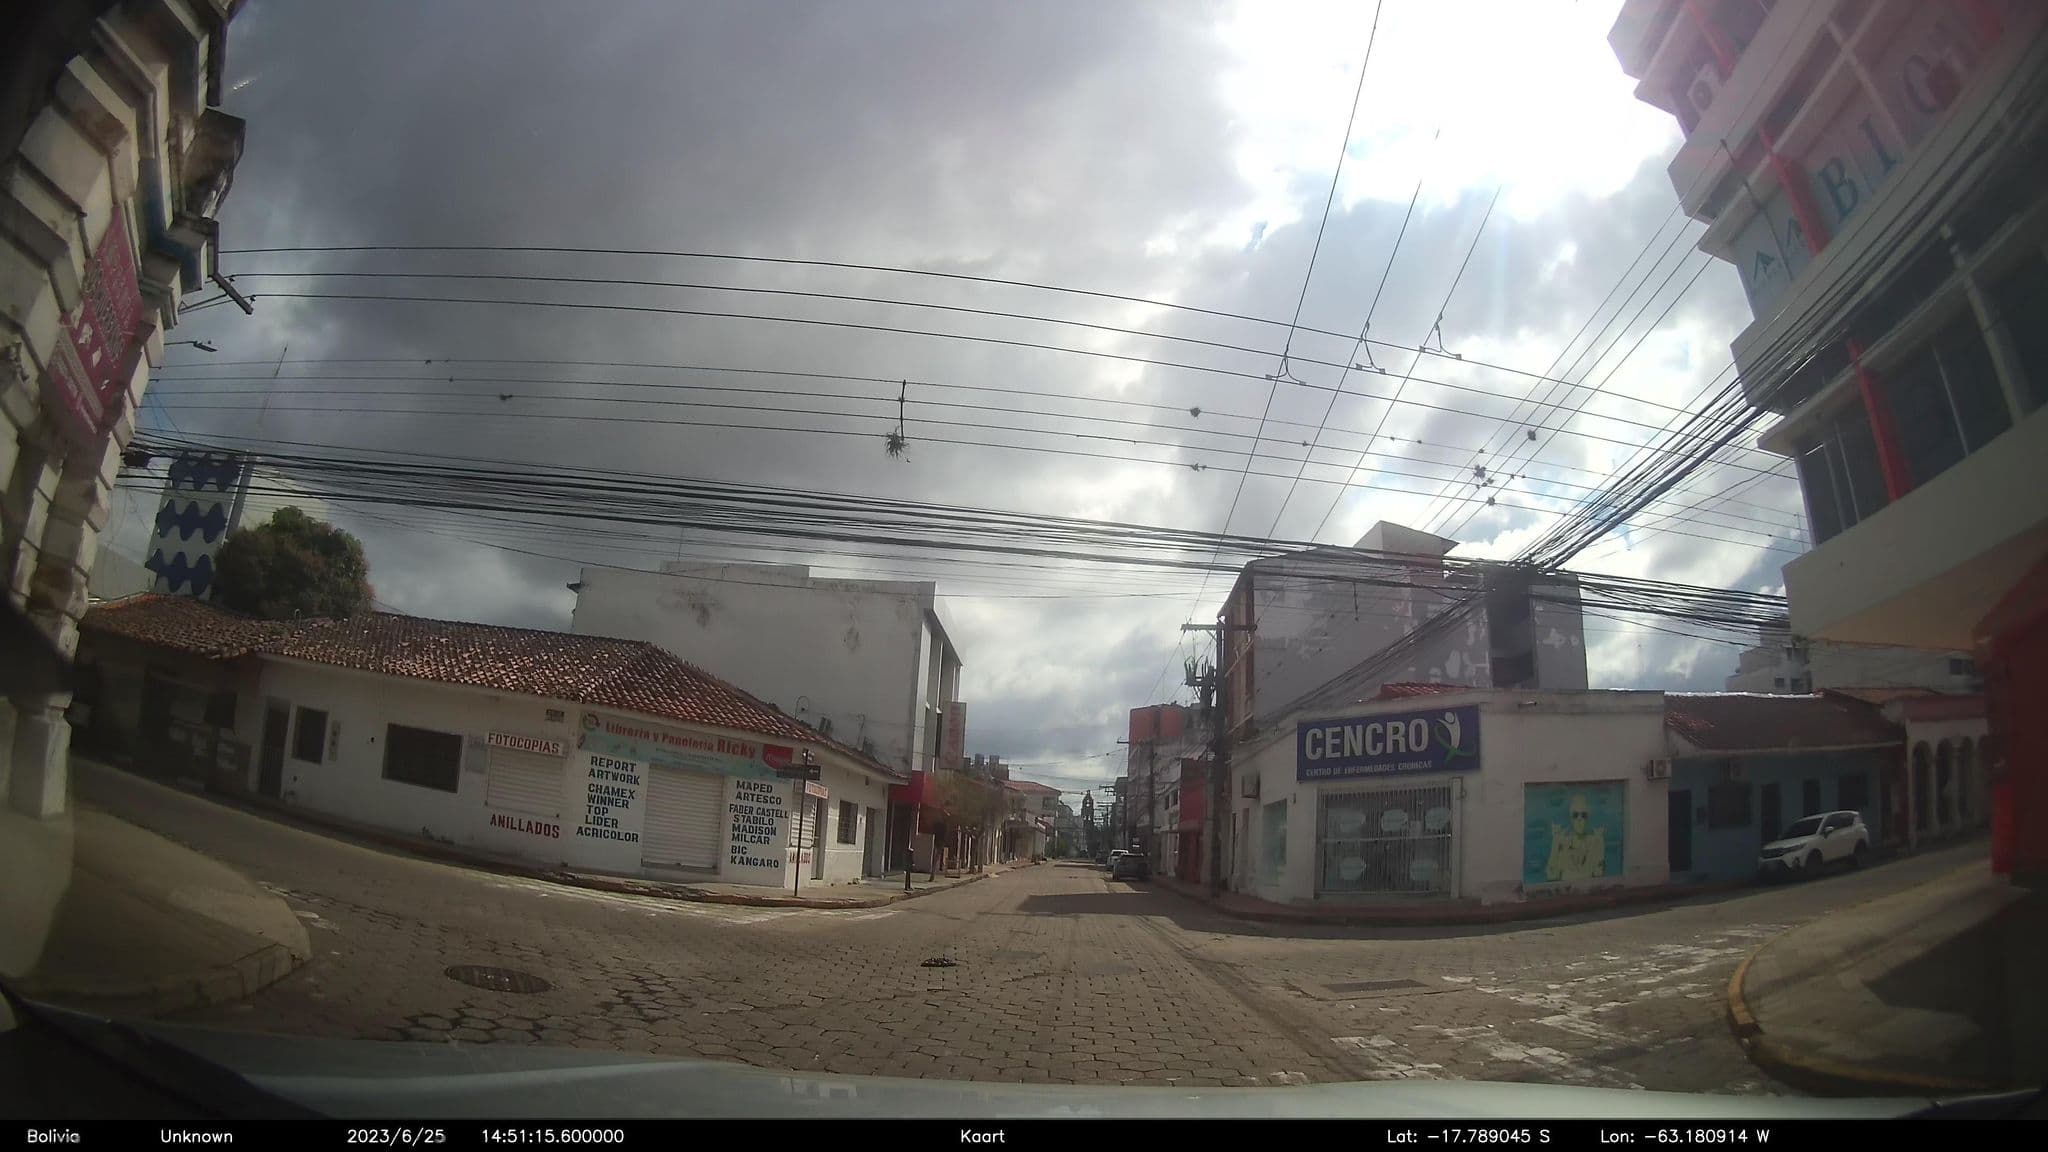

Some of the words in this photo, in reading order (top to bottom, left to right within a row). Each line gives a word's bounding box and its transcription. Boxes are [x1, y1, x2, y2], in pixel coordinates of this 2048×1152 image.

[488, 732, 560, 754] FOTOCOPIAS
[1306, 719, 1429, 760] CENCRO
[717, 737, 757, 759] Ricky
[590, 755, 637, 773] REPORT
[588, 768, 641, 786] ARTWORK
[588, 783, 636, 800] CHAMEX
[736, 780, 773, 793] MAPED
[587, 793, 630, 809] WINNER
[735, 791, 782, 805] ARTESCO
[586, 804, 609, 816] TOP
[729, 803, 754, 814] FABER
[756, 807, 790, 819] CASTELL
[490, 814, 561, 839] ANILLADOS
[585, 814, 619, 829] LIDER
[733, 814, 774, 826] STABILO
[576, 825, 640, 843] ACRICOLOR
[732, 823, 777, 836] MADISON
[731, 833, 771, 845] MILCAR
[731, 845, 748, 855] BIC
[730, 856, 780, 869] KANGARO
